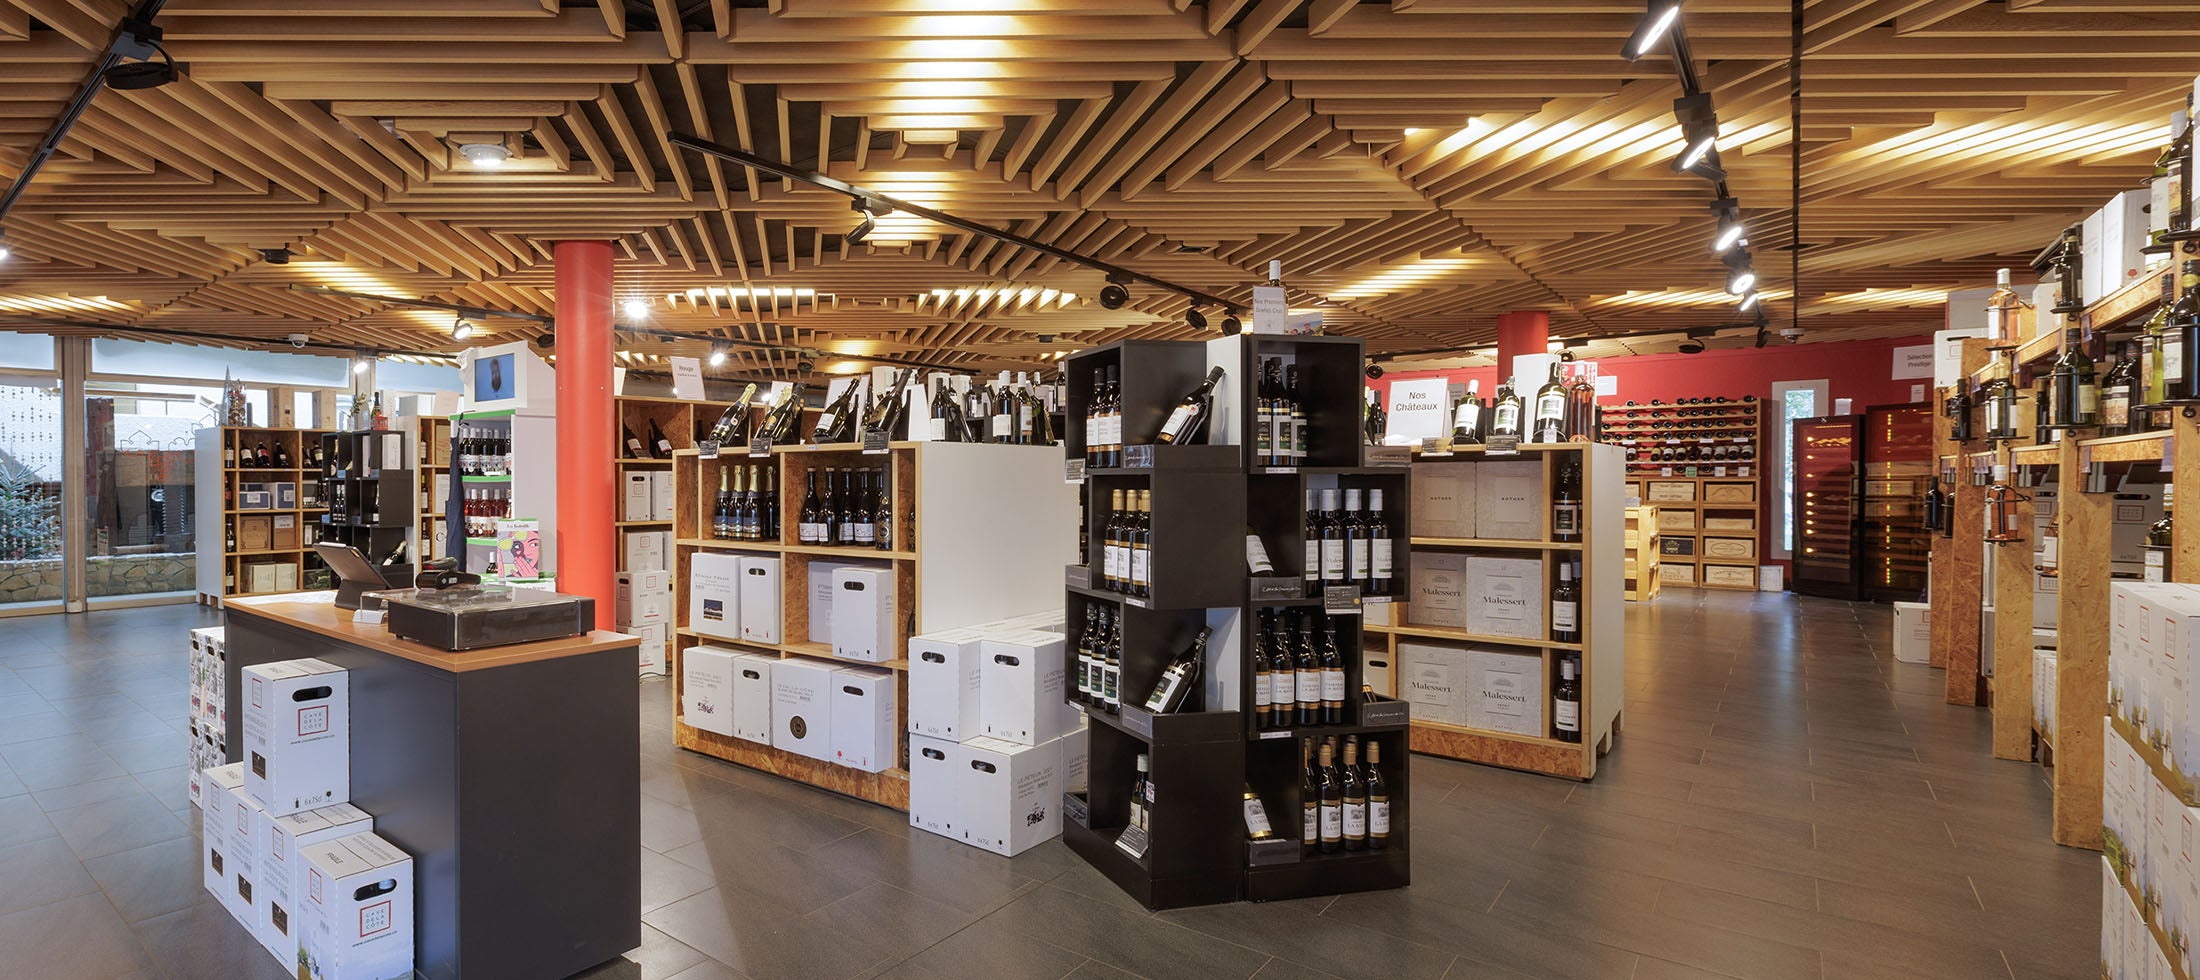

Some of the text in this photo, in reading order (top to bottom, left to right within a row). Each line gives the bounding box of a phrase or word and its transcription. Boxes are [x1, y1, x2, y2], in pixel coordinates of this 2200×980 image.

[1408, 391, 1427, 400] Nos
[1395, 402, 1438, 411] Châteaux
[1422, 588, 1461, 597] Malessert
[1483, 596, 1527, 606] Malessert
[1411, 681, 1452, 693] Malessert
[1482, 690, 1528, 703] Malessert
[366, 908, 384, 918] CAVE
